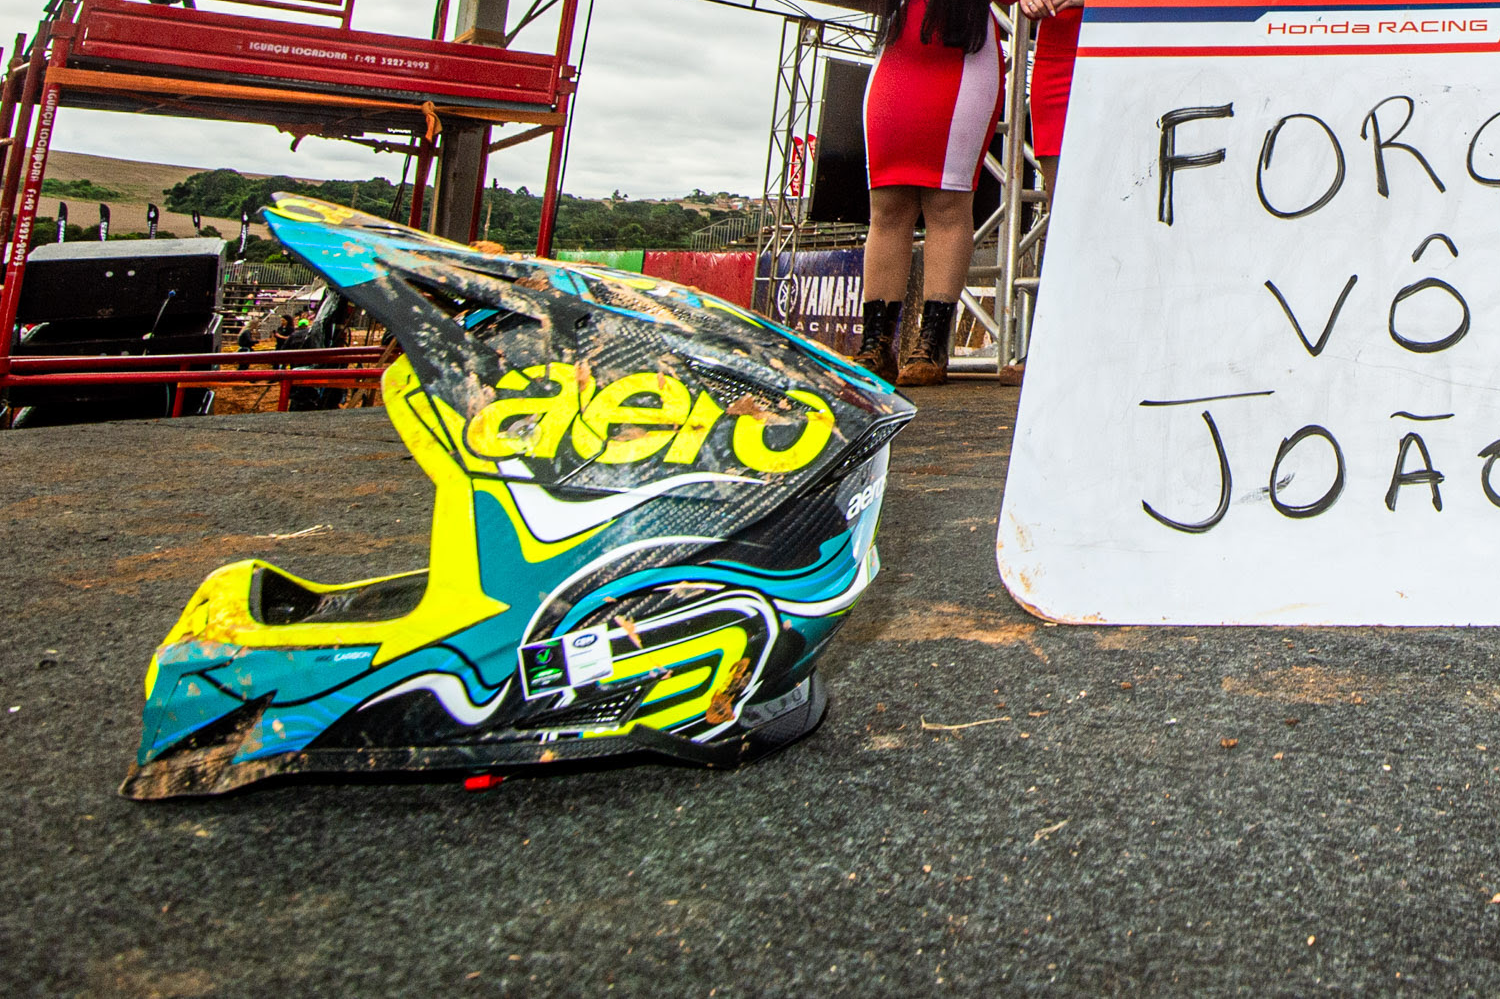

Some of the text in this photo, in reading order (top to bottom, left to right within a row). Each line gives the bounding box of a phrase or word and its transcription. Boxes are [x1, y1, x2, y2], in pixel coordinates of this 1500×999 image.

[1267, 19, 1488, 34] Honda RACING
[249, 41, 289, 54] IGUAÇU
[291, 46, 348, 61] LOCADORA
[1264, 233, 1471, 357] VÔ
[792, 321, 864, 334] ACING
[463, 362, 836, 474] aero
